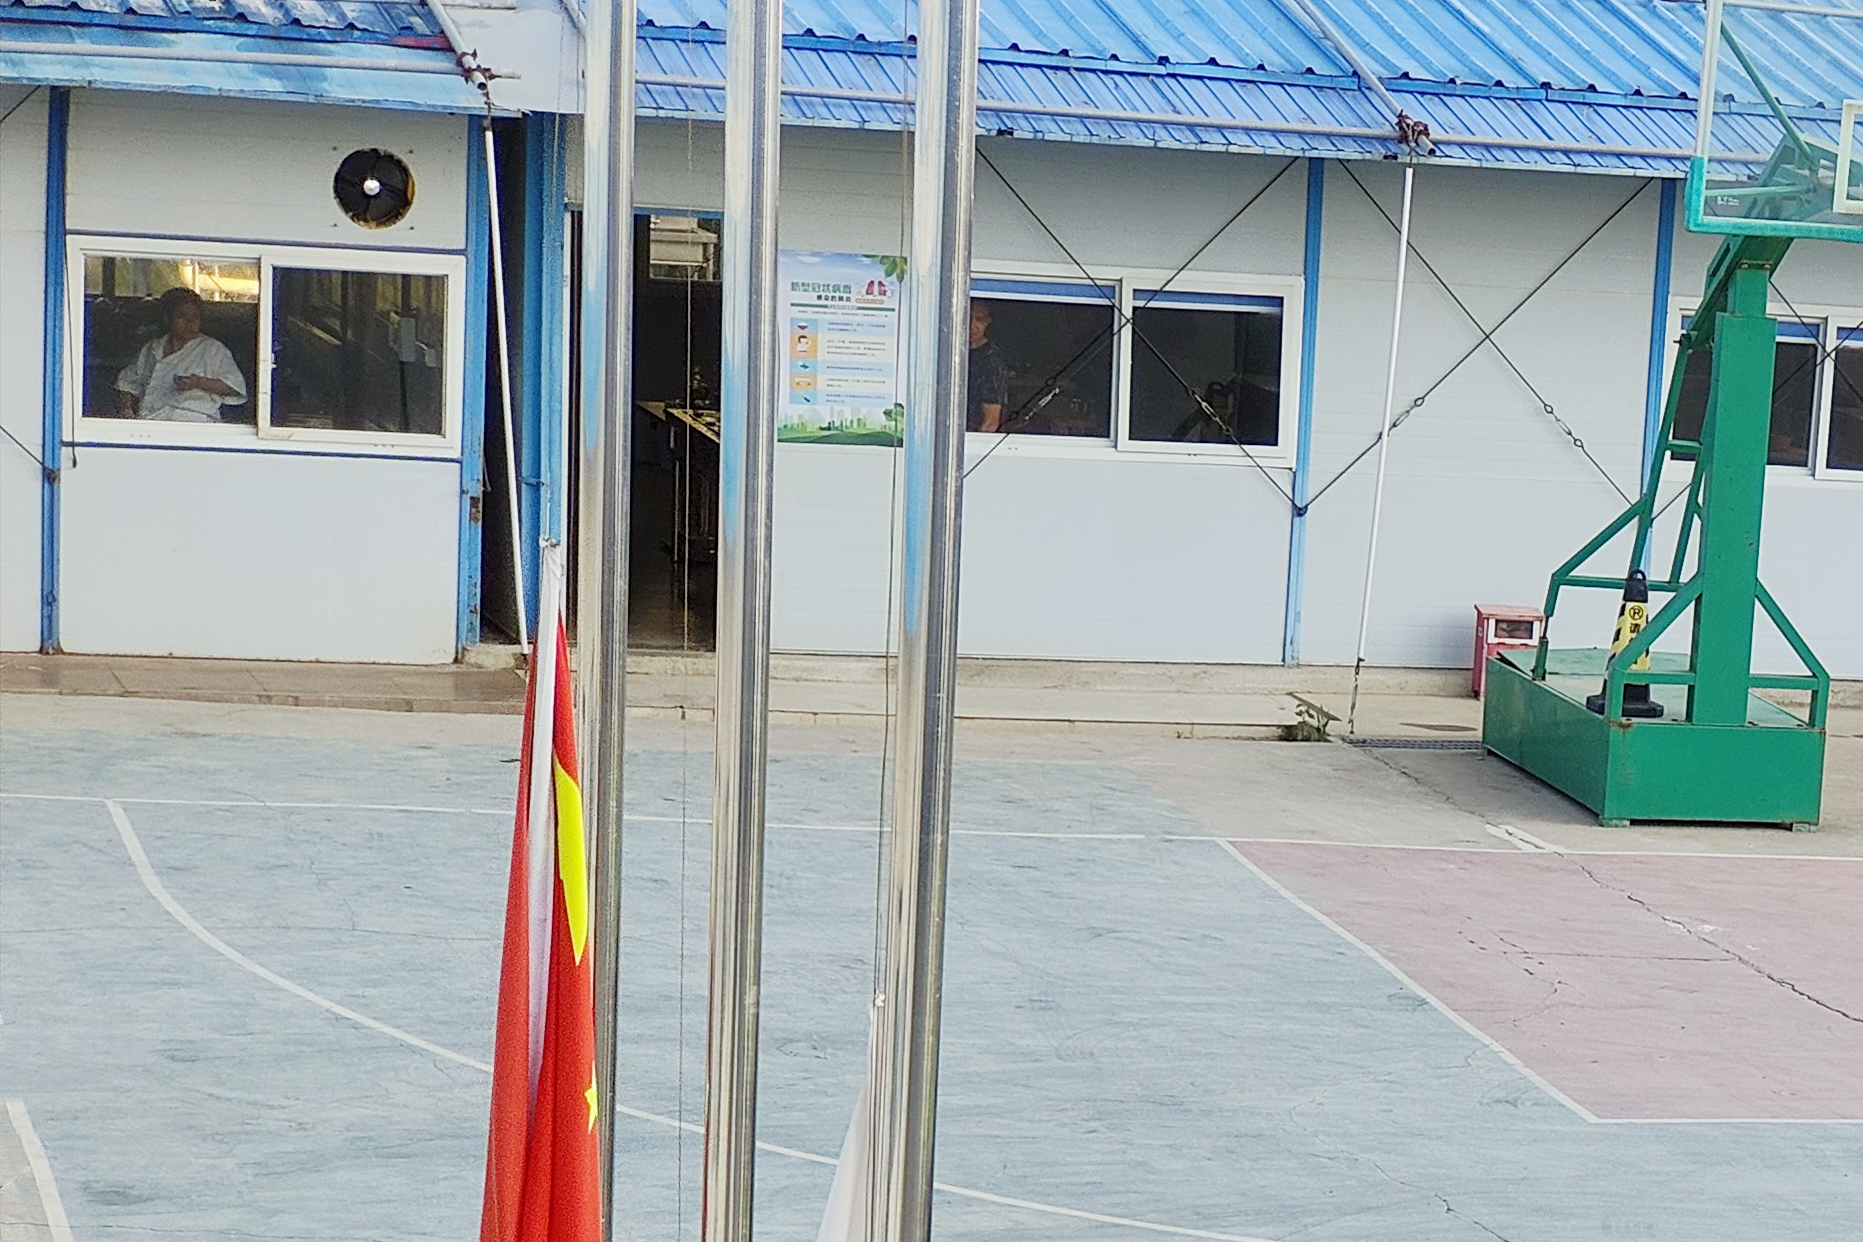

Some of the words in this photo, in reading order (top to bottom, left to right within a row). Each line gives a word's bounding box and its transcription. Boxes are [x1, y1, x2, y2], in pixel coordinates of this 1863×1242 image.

[791, 281, 852, 294] 新型冠状病毒
